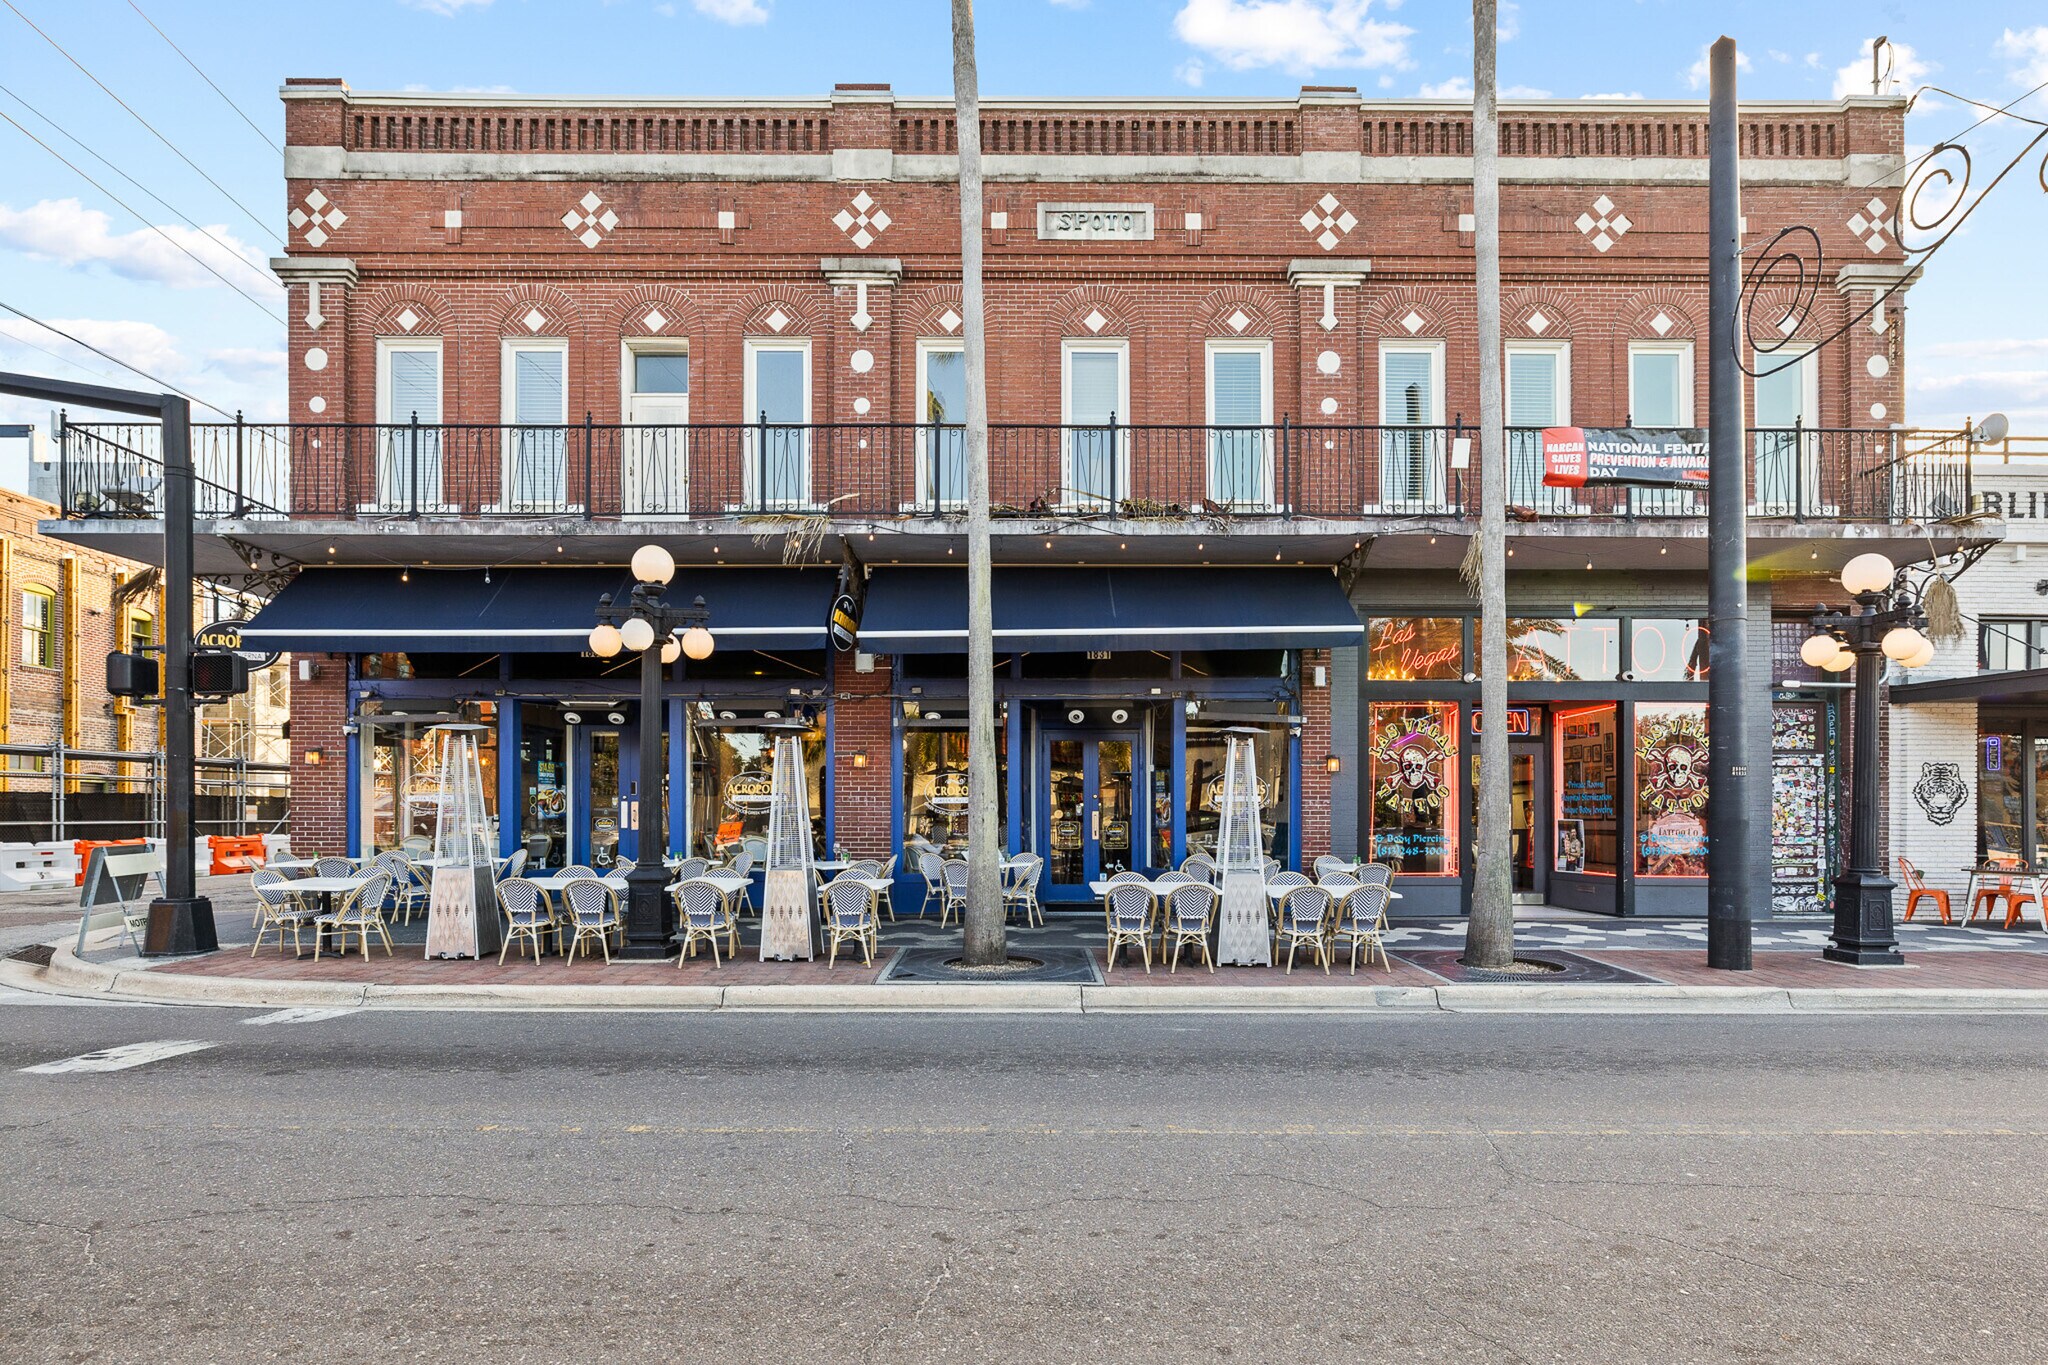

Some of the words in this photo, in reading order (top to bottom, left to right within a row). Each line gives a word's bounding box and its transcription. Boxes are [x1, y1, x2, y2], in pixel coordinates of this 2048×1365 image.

[1058, 212, 1134, 232] SPOTO
[1546, 441, 1585, 453] NARCAN
[1587, 441, 1661, 455] NATIONAL
[1663, 442, 1709, 455] FENTA
[1551, 453, 1582, 464] SAVES
[1589, 452, 1657, 468] PREVENTION
[1658, 457, 1669, 468] &
[1554, 464, 1580, 475] LIVES
[1589, 467, 1619, 478] DAY
[1372, 622, 1416, 652] Las
[1400, 642, 1460, 676] Vegas
[1513, 625, 1710, 675] ATTOO
[1473, 711, 1526, 733] OEN
[1369, 722, 1400, 759] LAS
[1403, 717, 1460, 758] VEGAS
[1635, 723, 1664, 759] LAS
[1989, 739, 1998, 769] OPEN
[1375, 784, 1450, 814] TATTOO
[1387, 833, 1411, 845] Body
[1412, 833, 1451, 845] Piercing
